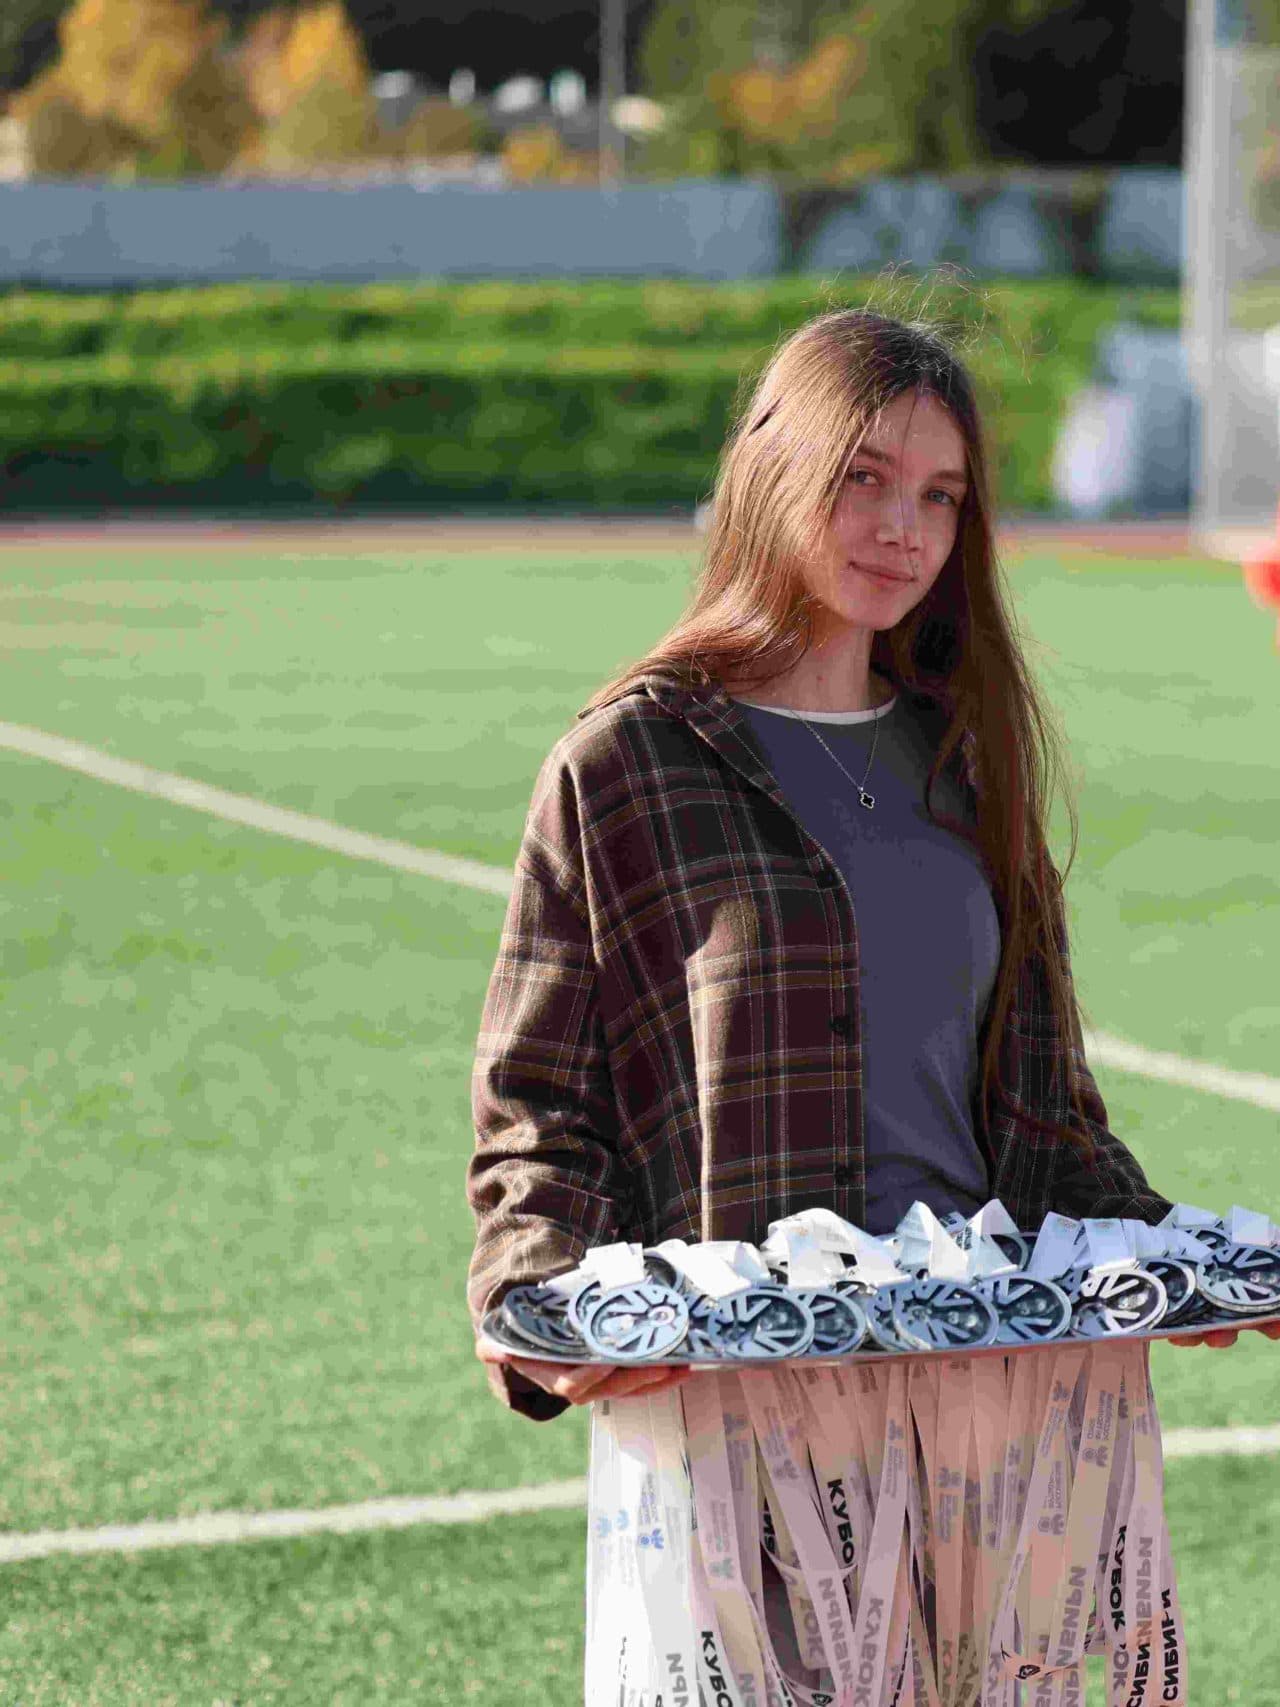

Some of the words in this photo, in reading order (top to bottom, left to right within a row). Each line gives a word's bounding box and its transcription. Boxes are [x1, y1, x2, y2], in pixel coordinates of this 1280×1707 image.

[827, 1478, 855, 1564] КУБО
[1109, 1525, 1127, 1632] КУБОК
[702, 1631, 734, 1707] КУБО
[1126, 1643, 1151, 1707] СИБИ
